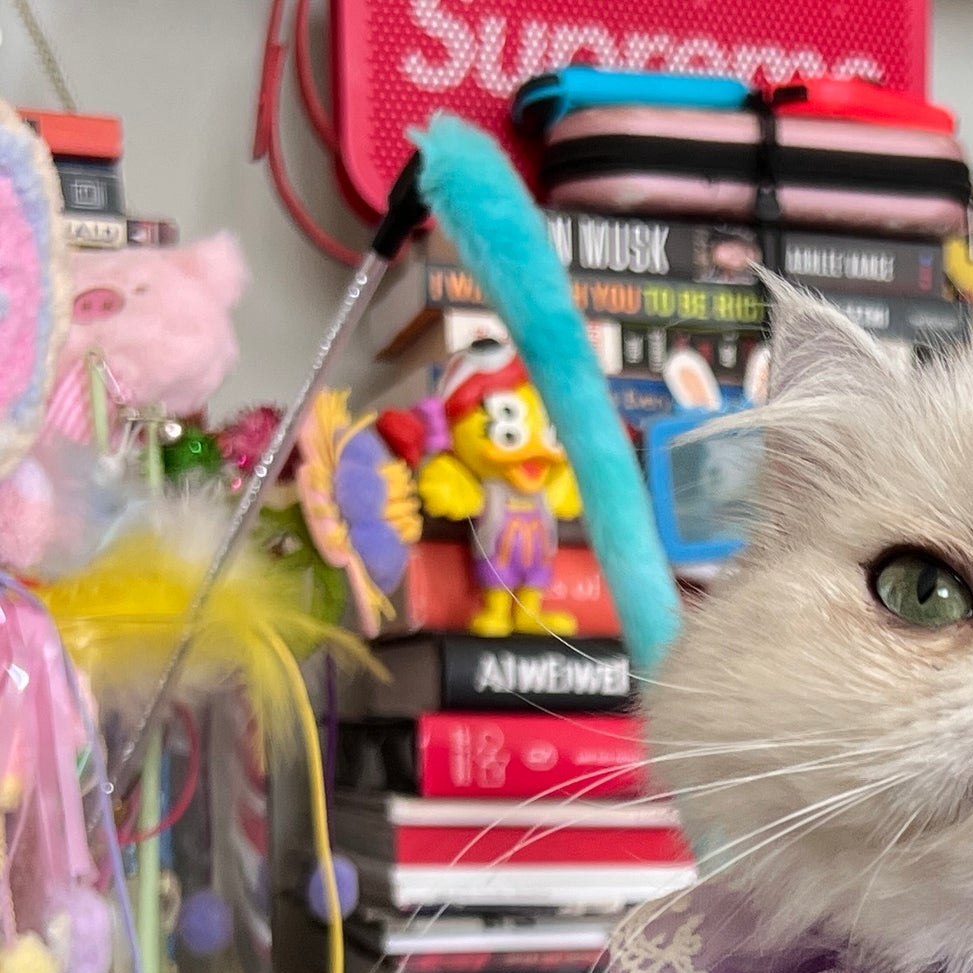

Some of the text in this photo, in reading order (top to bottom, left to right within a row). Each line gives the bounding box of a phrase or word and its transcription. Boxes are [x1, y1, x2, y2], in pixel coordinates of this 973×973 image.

[578, 215, 670, 275] MUSK
[591, 281, 642, 315] YOU
[644, 284, 675, 318] TO
[712, 288, 765, 323] RIC
